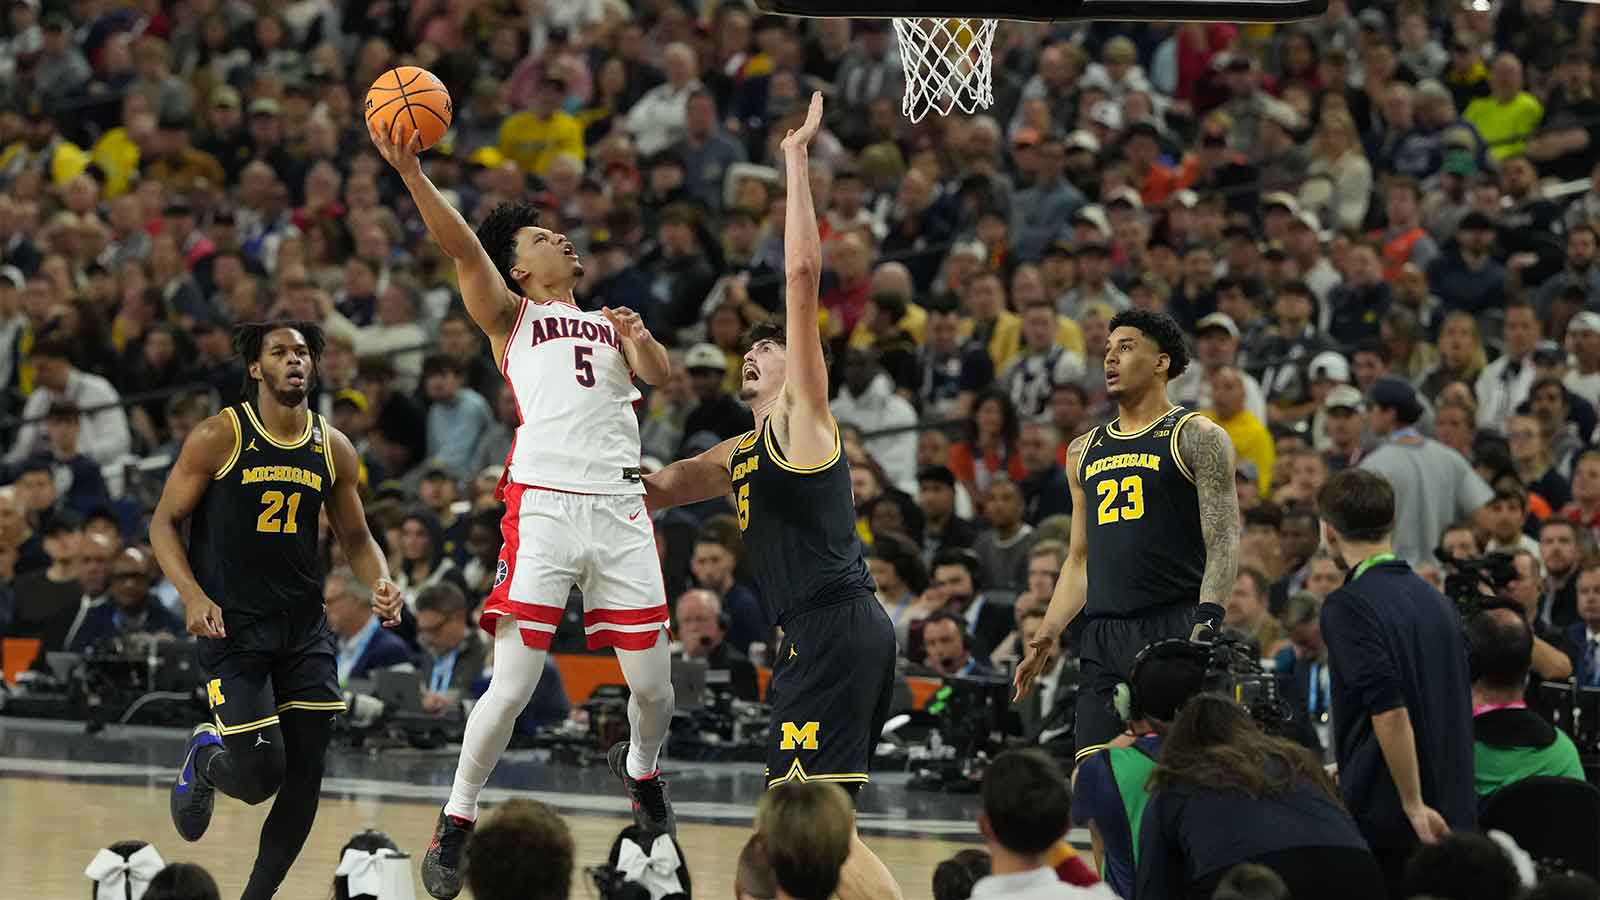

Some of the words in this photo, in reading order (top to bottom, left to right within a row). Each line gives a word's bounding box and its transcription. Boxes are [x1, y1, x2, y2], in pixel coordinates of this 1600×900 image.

[574, 345, 596, 388] 5
[241, 466, 322, 492] MICHIGAN
[1085, 453, 1161, 482] MICHIGAN
[256, 490, 302, 534] 21
[1096, 475, 1145, 525] 23
[780, 721, 820, 750] M
